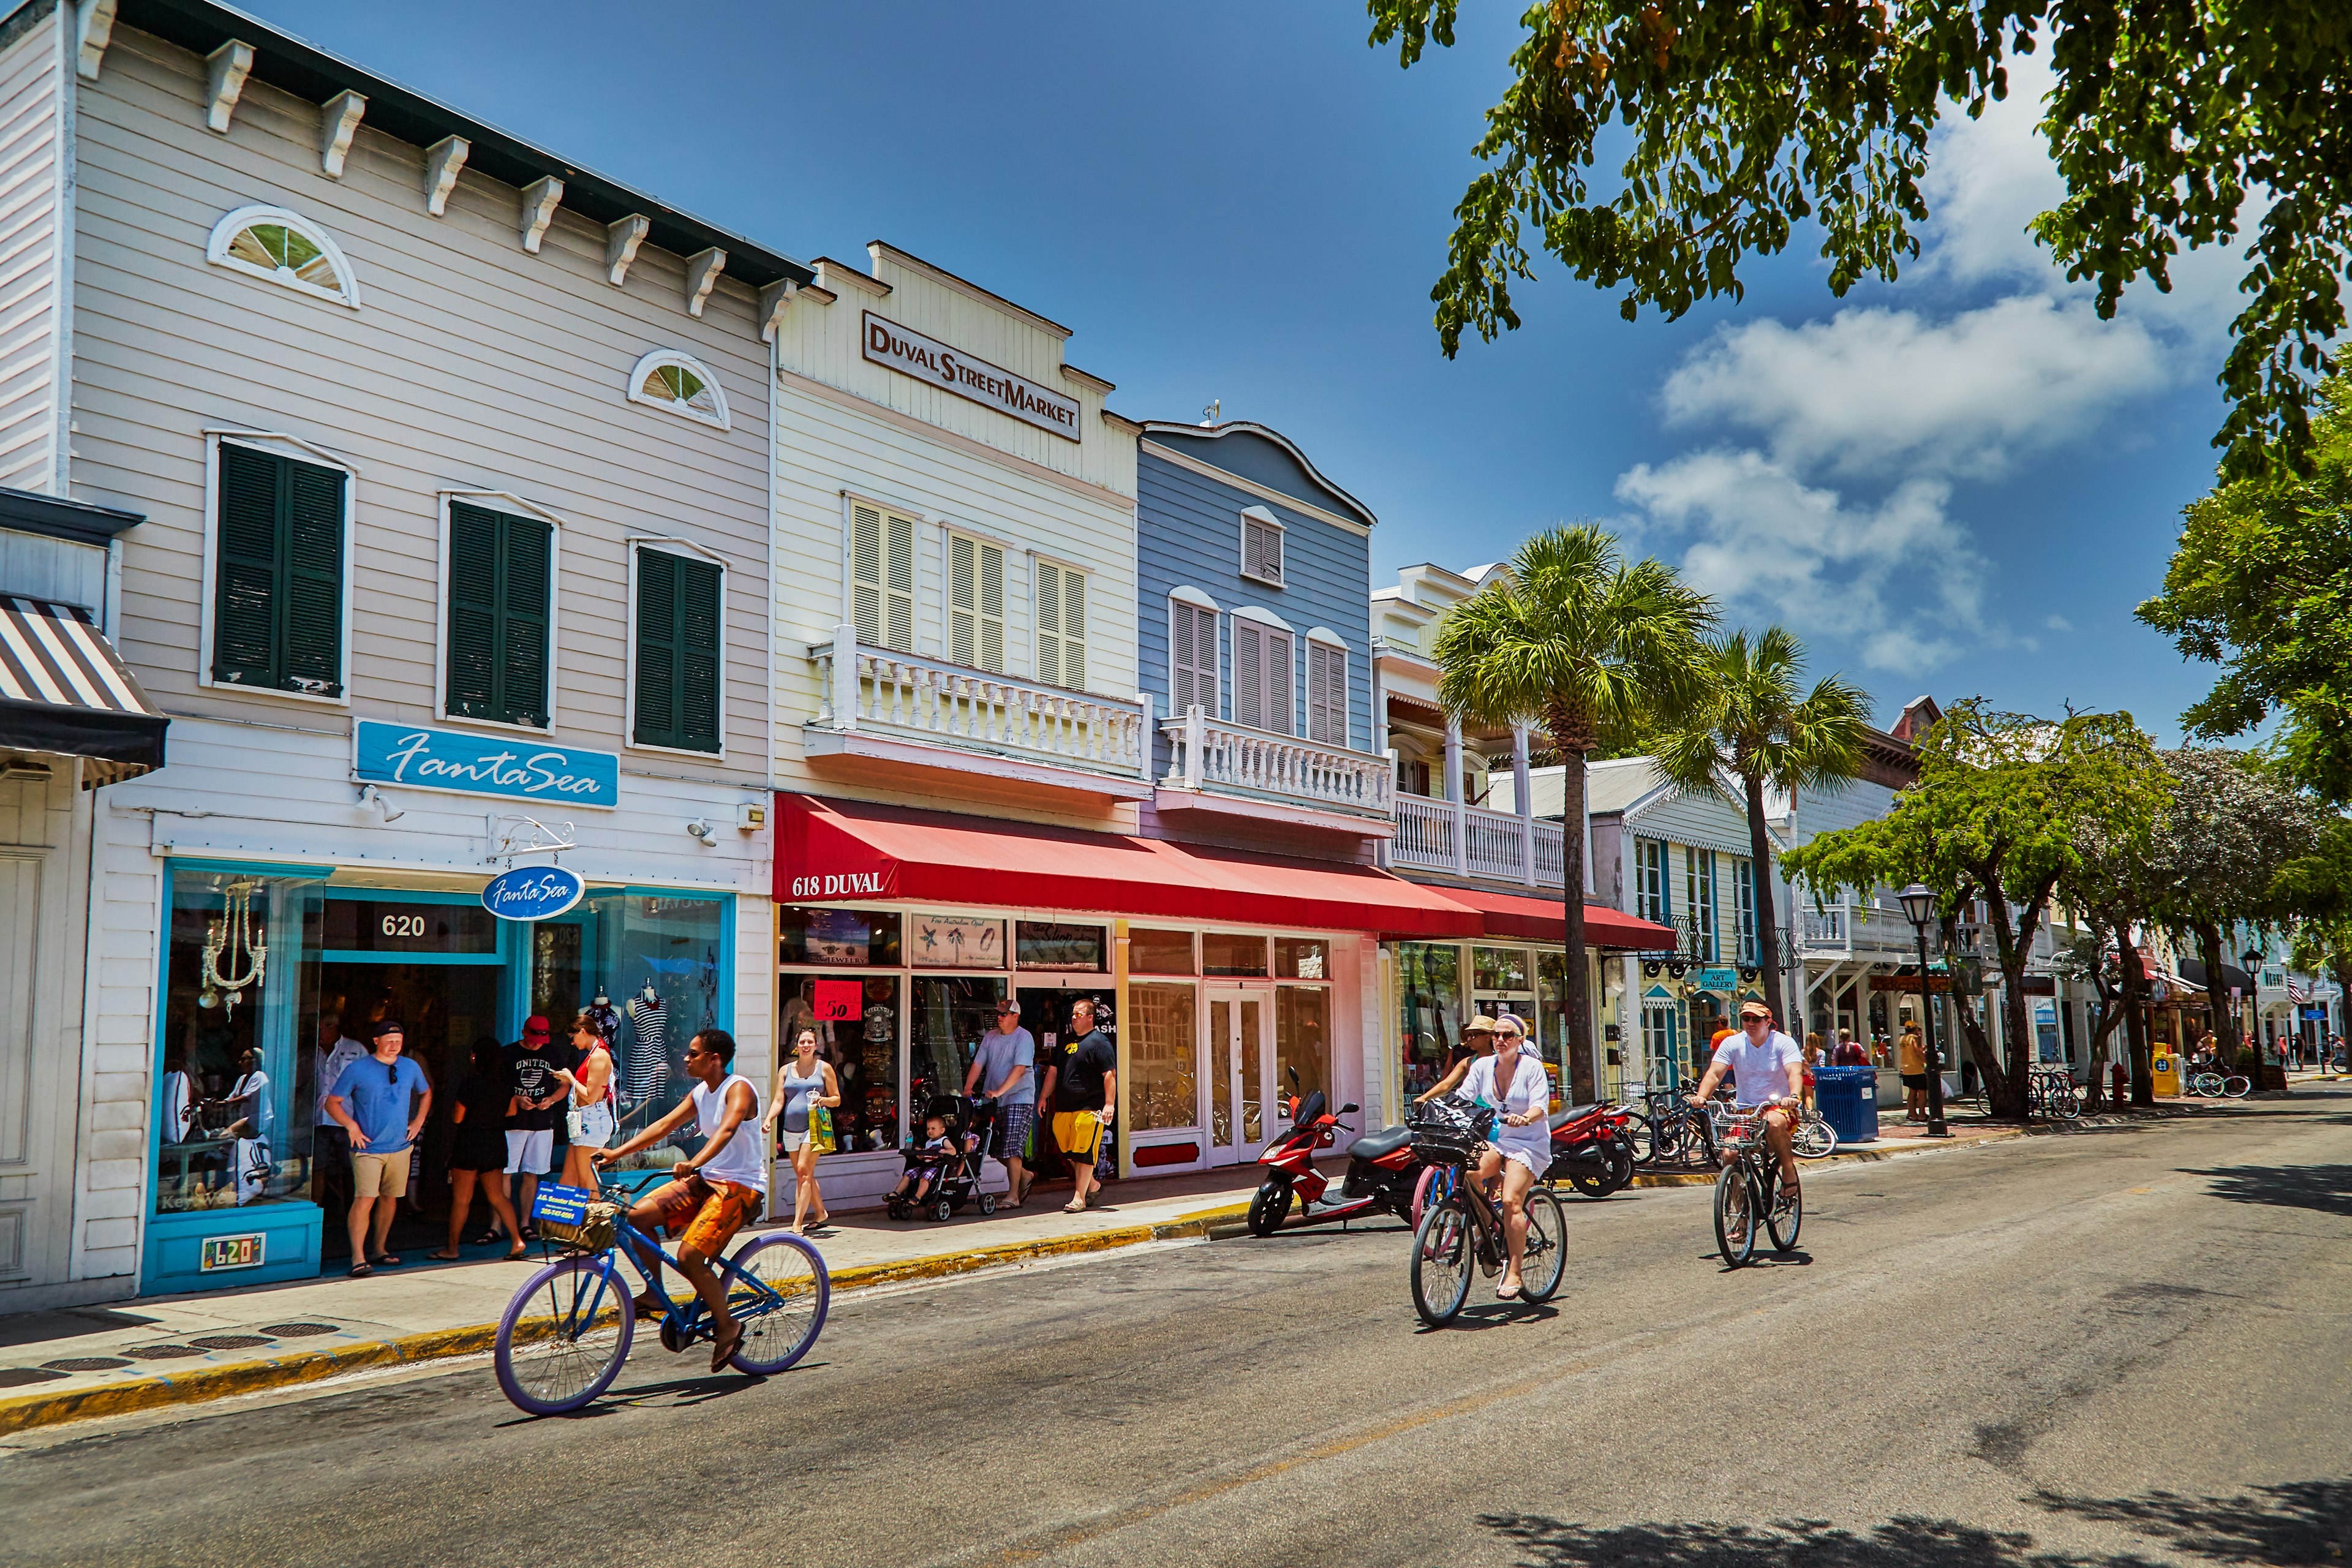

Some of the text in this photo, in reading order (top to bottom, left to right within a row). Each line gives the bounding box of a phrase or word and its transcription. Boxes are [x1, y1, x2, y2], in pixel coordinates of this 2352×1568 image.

[386, 733, 601, 794] FantaSea
[494, 875, 568, 908] FantaSea
[793, 872, 884, 896] 618 DUVAL
[382, 915, 425, 937] 620
[825, 1000, 847, 1017] 50
[516, 1059, 550, 1069] UNITED
[162, 1195, 191, 1210] Key
[216, 1240, 252, 1265] 620
